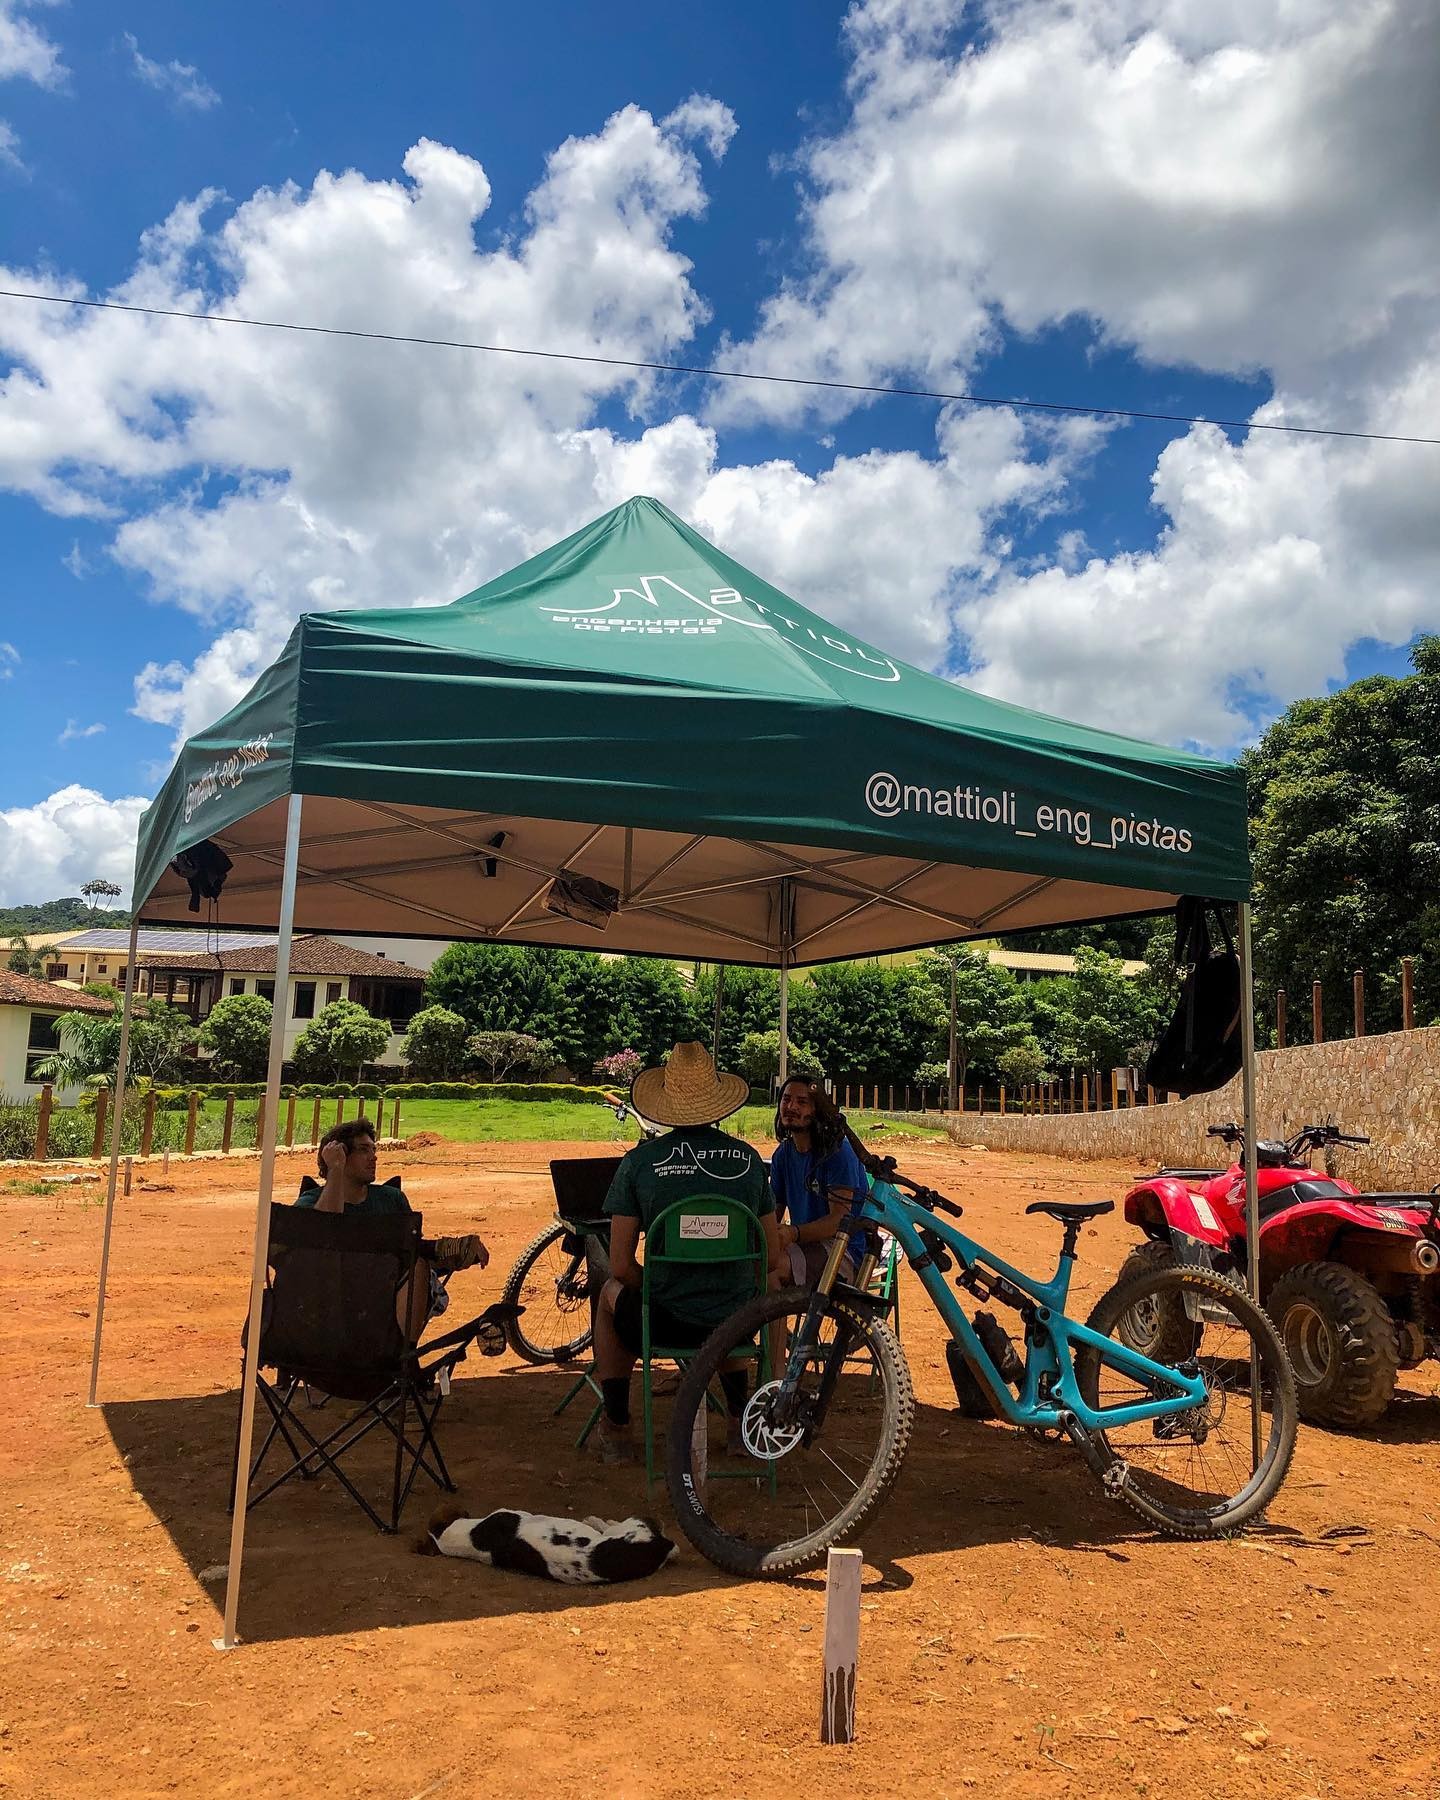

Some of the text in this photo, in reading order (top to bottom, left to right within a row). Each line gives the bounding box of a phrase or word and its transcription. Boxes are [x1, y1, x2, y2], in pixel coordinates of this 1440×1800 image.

[864, 771, 1193, 853] @mattioli_eng_pistas
[1182, 1275, 1234, 1297] MAXXIS
[682, 1473, 705, 1516] DT SWISS
